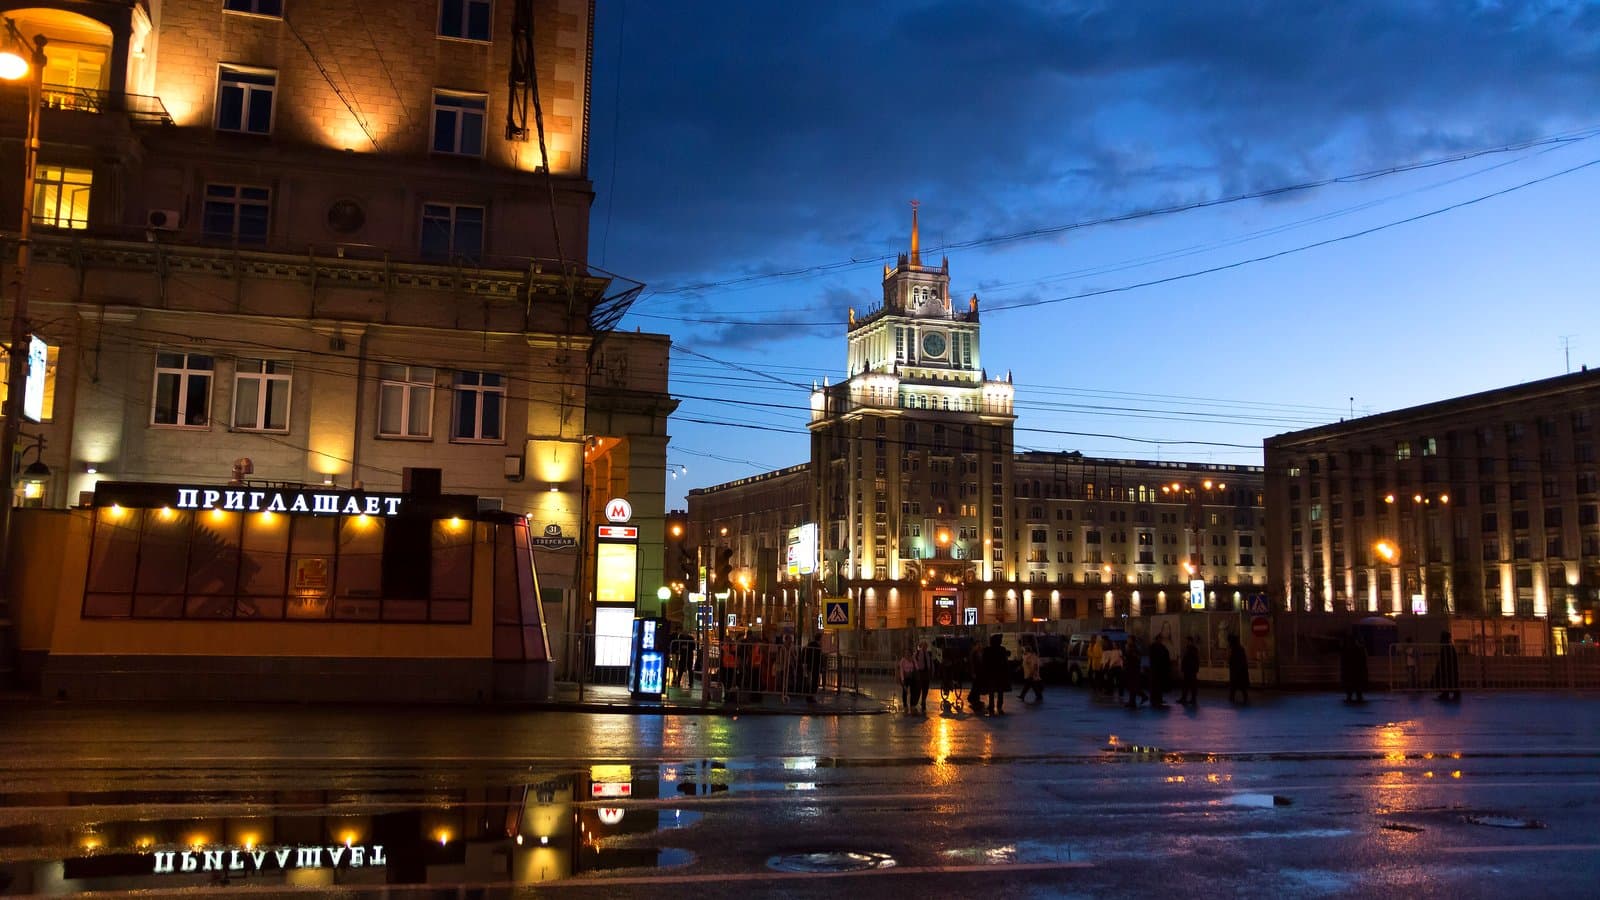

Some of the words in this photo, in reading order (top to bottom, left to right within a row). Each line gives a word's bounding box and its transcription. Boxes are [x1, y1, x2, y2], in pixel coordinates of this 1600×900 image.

[178, 489, 401, 515] ПРИГЛАШАЕТ
[611, 505, 626, 517] М
[548, 525, 557, 533] 31
